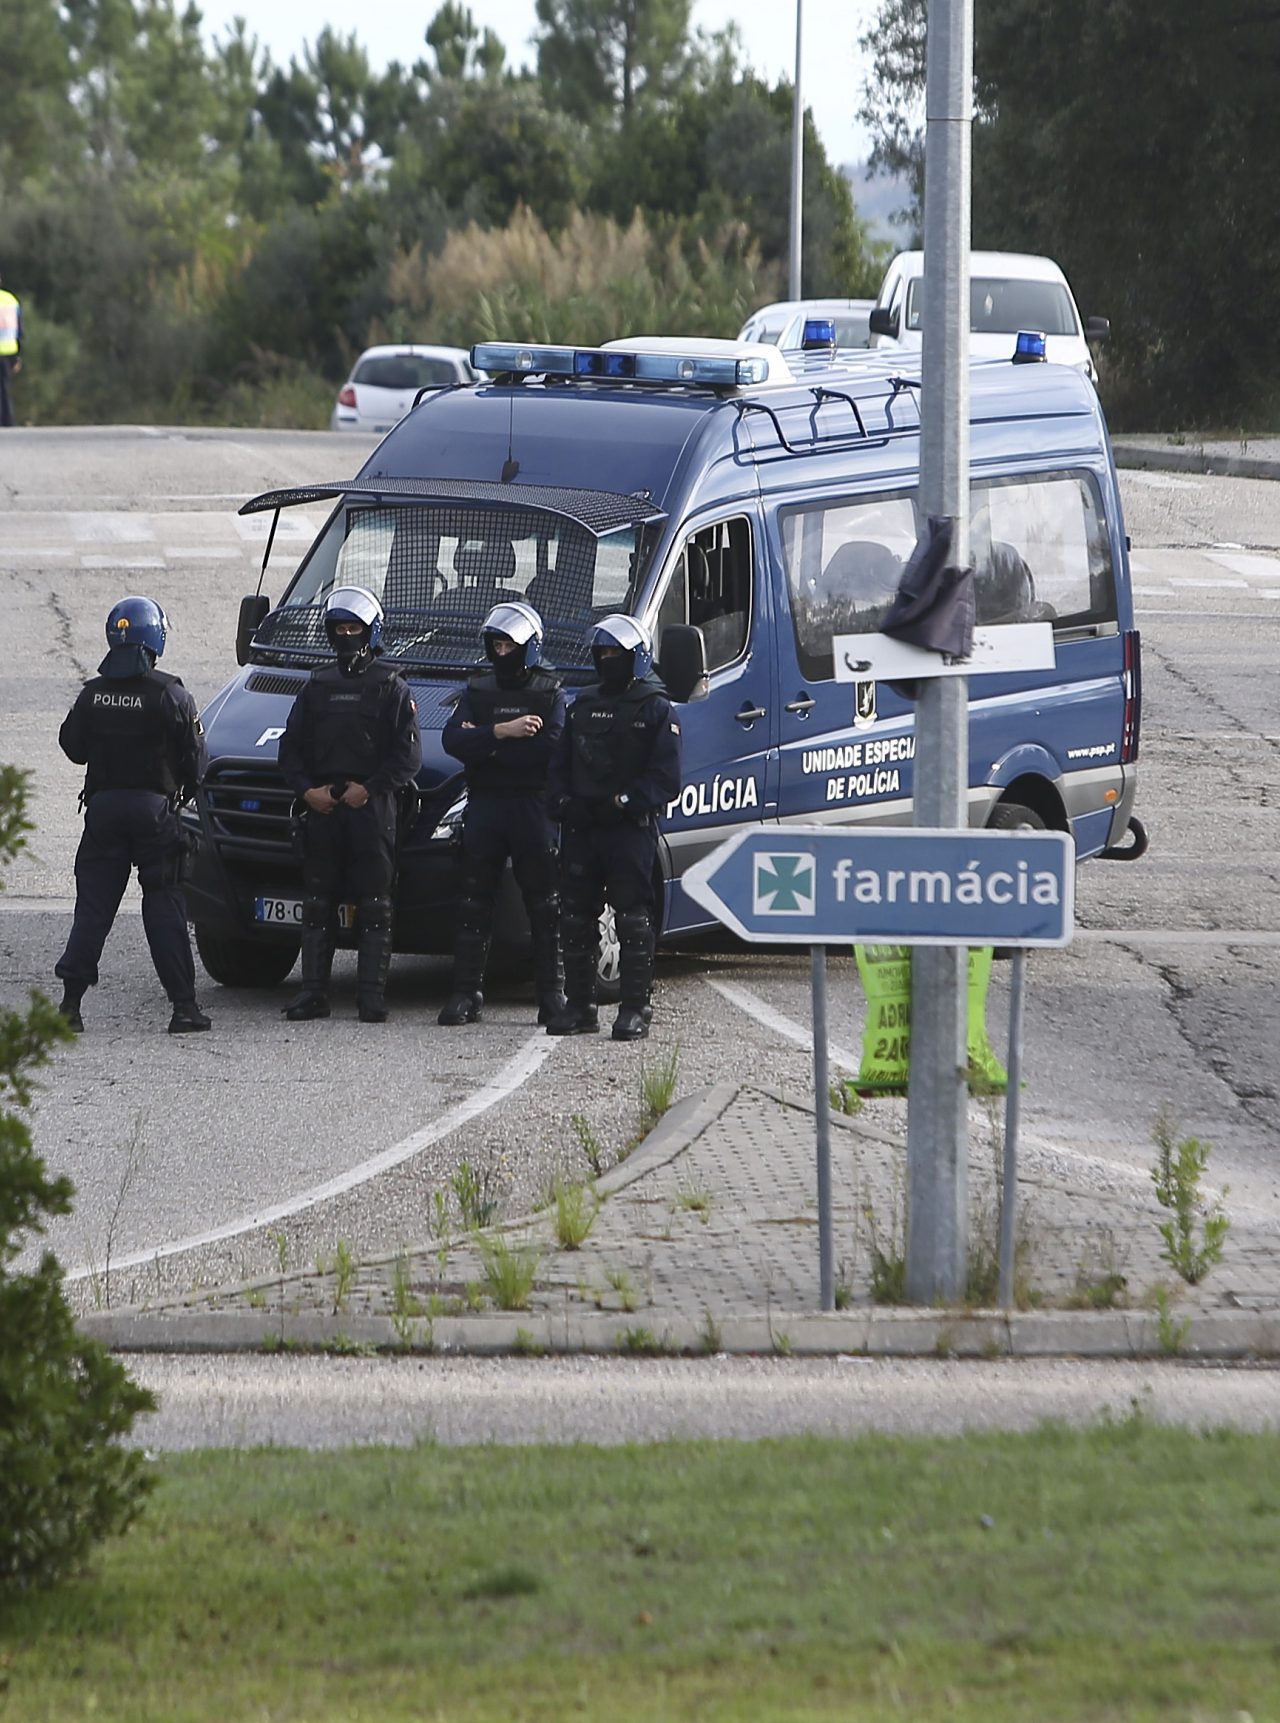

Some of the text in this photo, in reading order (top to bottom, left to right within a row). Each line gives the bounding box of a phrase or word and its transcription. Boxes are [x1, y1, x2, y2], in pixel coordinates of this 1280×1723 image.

[93, 693, 142, 708] POLICIA
[802, 745, 862, 774] UNIDADE
[826, 767, 900, 801] DE POLÍCIA
[832, 858, 1061, 905] farmácia
